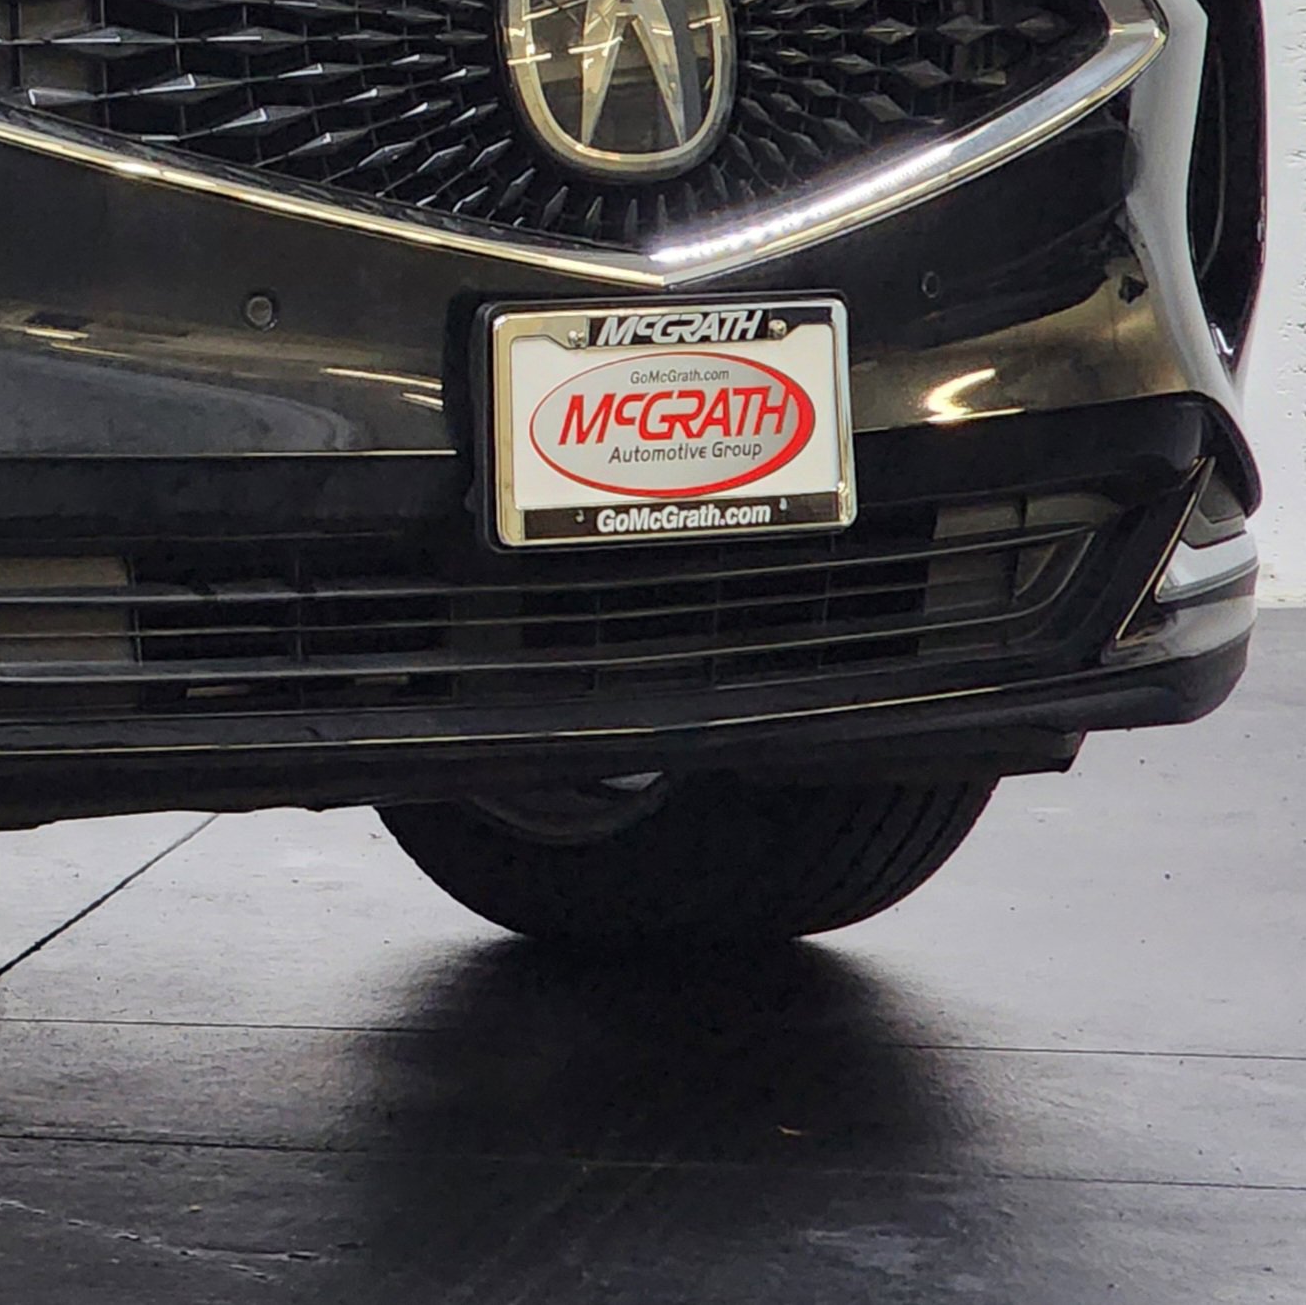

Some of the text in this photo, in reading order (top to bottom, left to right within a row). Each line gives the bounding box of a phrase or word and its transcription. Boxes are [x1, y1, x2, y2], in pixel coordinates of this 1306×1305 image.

[596, 309, 763, 346] McGRATH
[630, 367, 730, 385] GoMcGrath.com
[558, 385, 791, 446] McGRATH
[608, 440, 763, 464] Automotive Group
[597, 503, 771, 533] GoMcGrath.com
